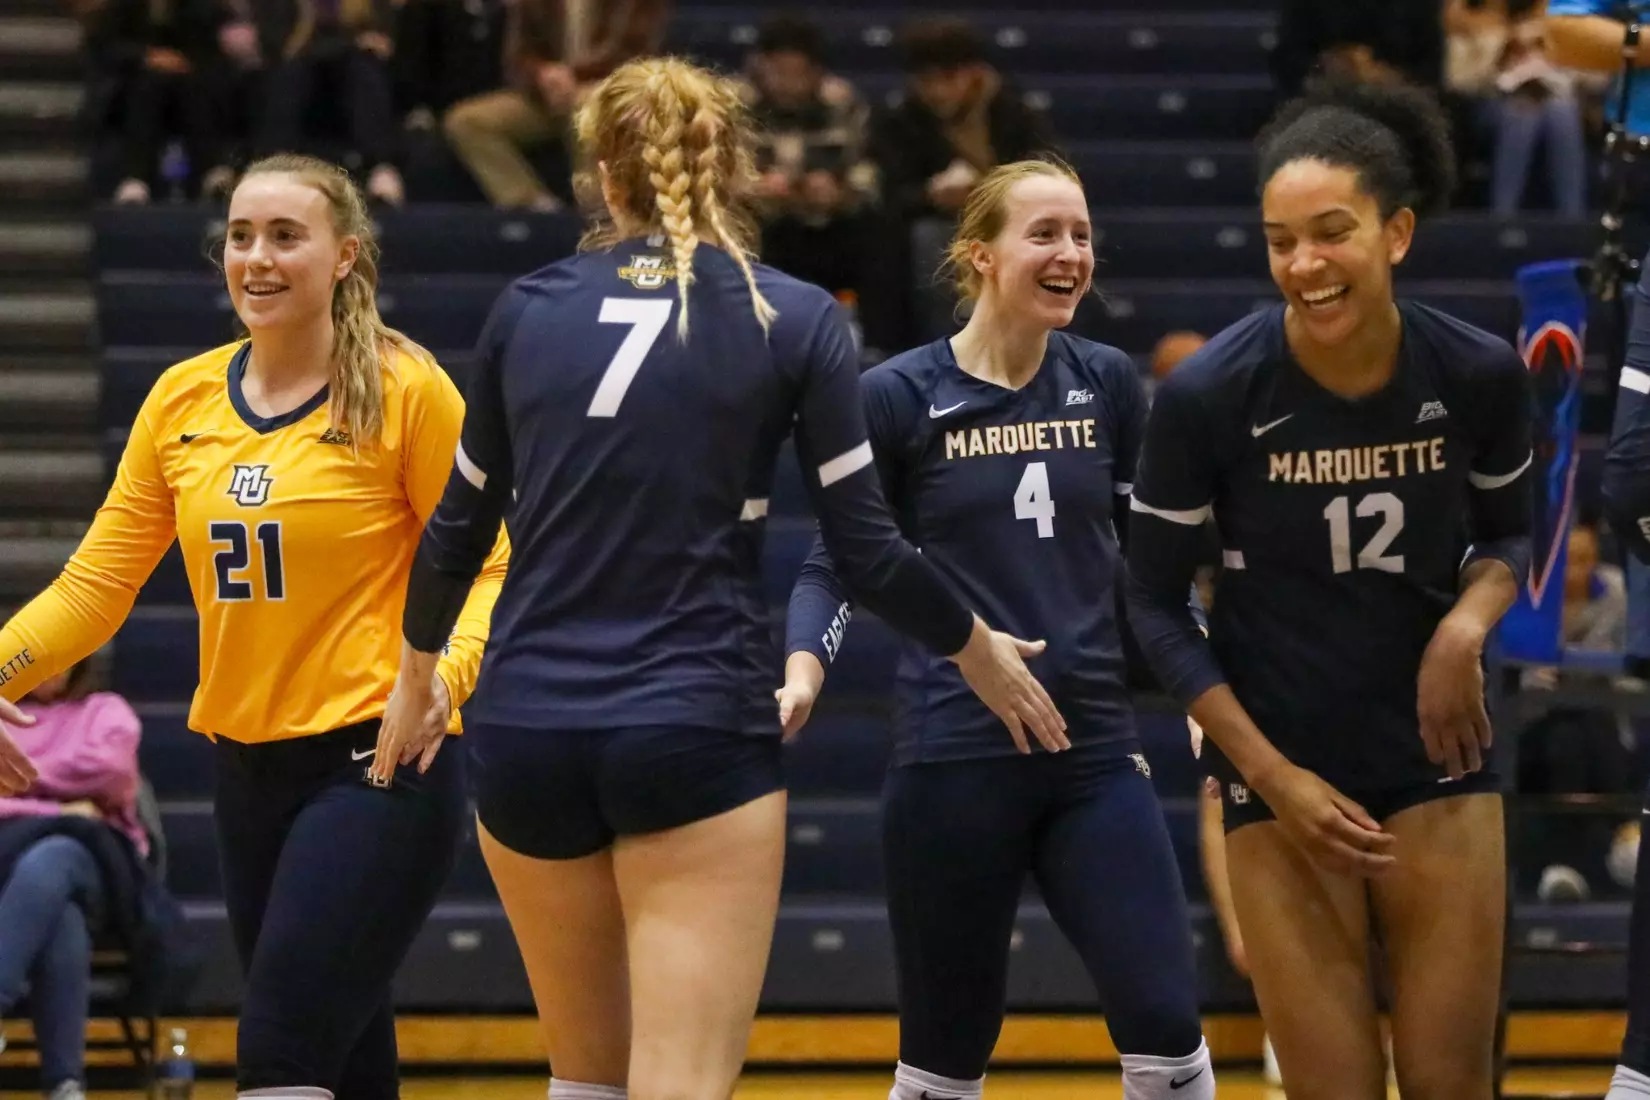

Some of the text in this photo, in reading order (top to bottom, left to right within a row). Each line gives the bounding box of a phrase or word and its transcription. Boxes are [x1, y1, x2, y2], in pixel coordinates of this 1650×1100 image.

[586, 297, 673, 418] 7
[945, 418, 1097, 460] MARQUETTE
[1268, 436, 1447, 484] MARQUETTE
[227, 464, 274, 507] MU
[1013, 461, 1056, 539] 4
[208, 520, 287, 602] 21
[1323, 491, 1406, 575] 12
